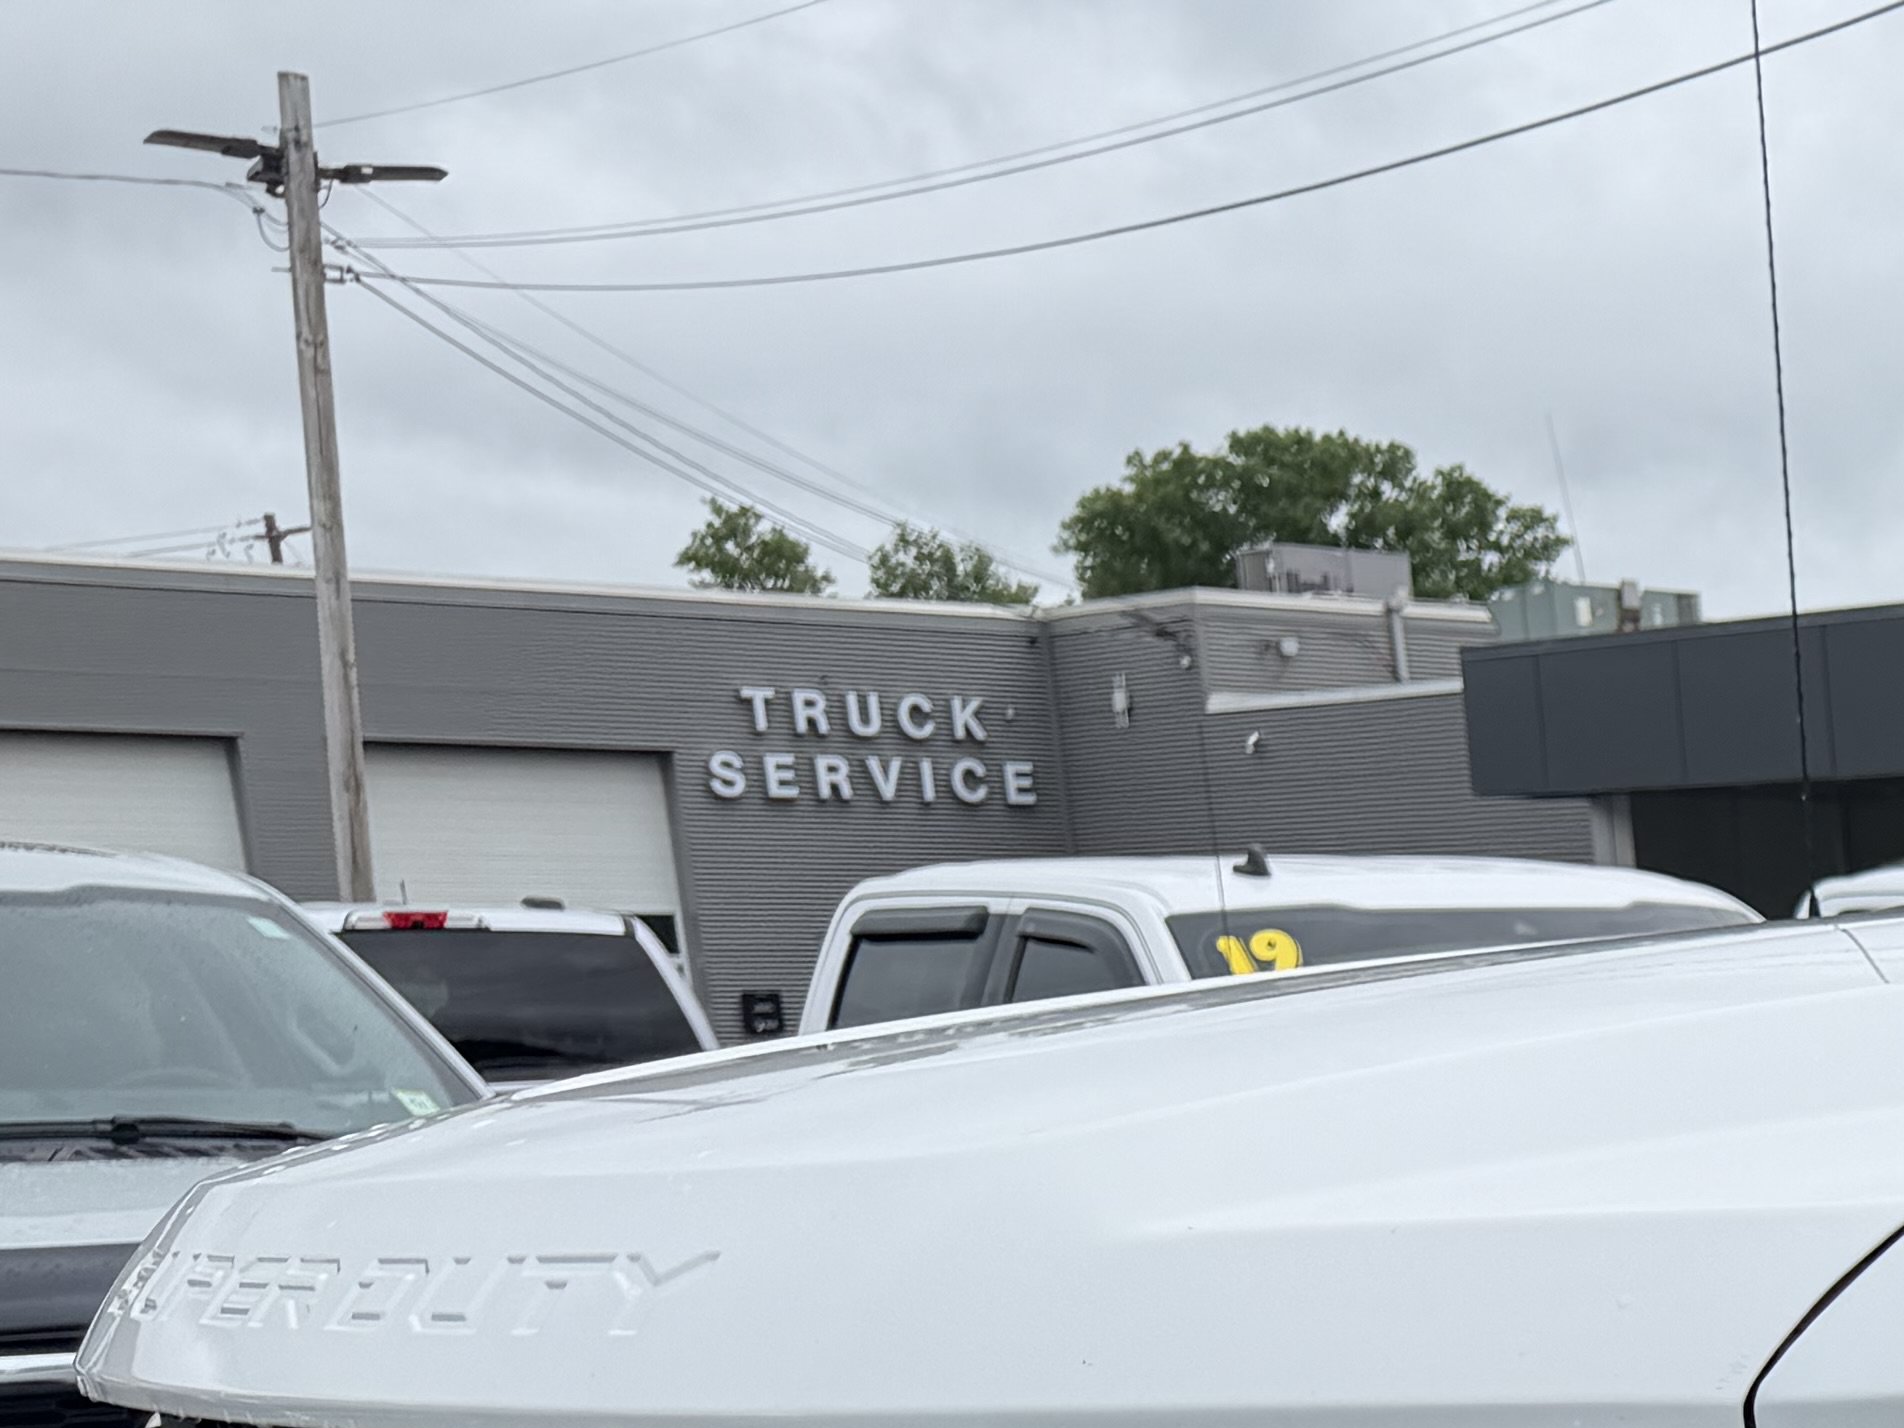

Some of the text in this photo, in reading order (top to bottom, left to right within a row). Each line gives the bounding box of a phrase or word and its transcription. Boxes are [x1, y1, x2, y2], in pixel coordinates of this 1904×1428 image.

[740, 686, 988, 741] TRUCK
[708, 750, 1038, 806] SERVICE
[324, 1250, 721, 1336] DUTY
